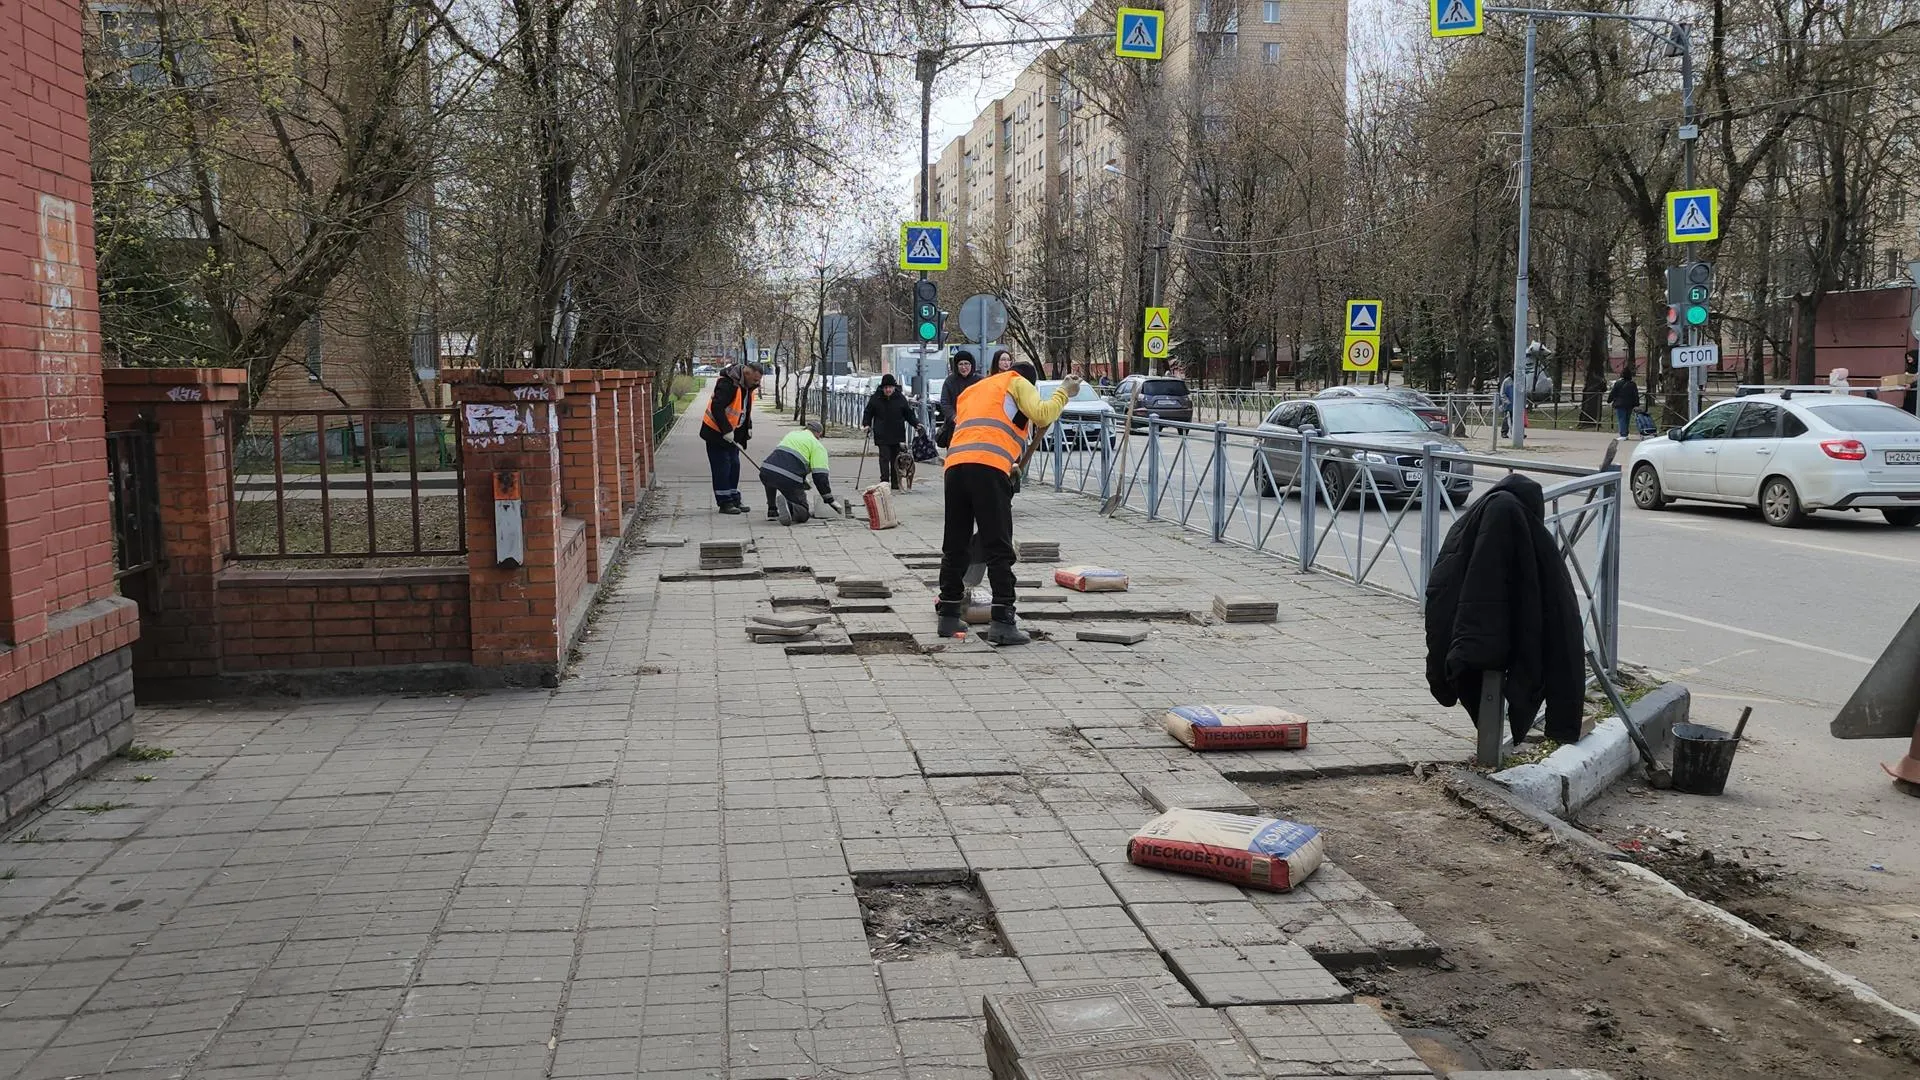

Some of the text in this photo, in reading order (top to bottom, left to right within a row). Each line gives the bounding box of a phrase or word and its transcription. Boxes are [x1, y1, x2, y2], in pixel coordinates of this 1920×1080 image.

[1150, 341, 1161, 350] 40
[1353, 347, 1370, 359] 30
[1679, 349, 1712, 363] СТОП
[1203, 729, 1285, 741] ПЕСКОБЕТОН
[1140, 844, 1248, 869] ПЕСКОБЕТОН
